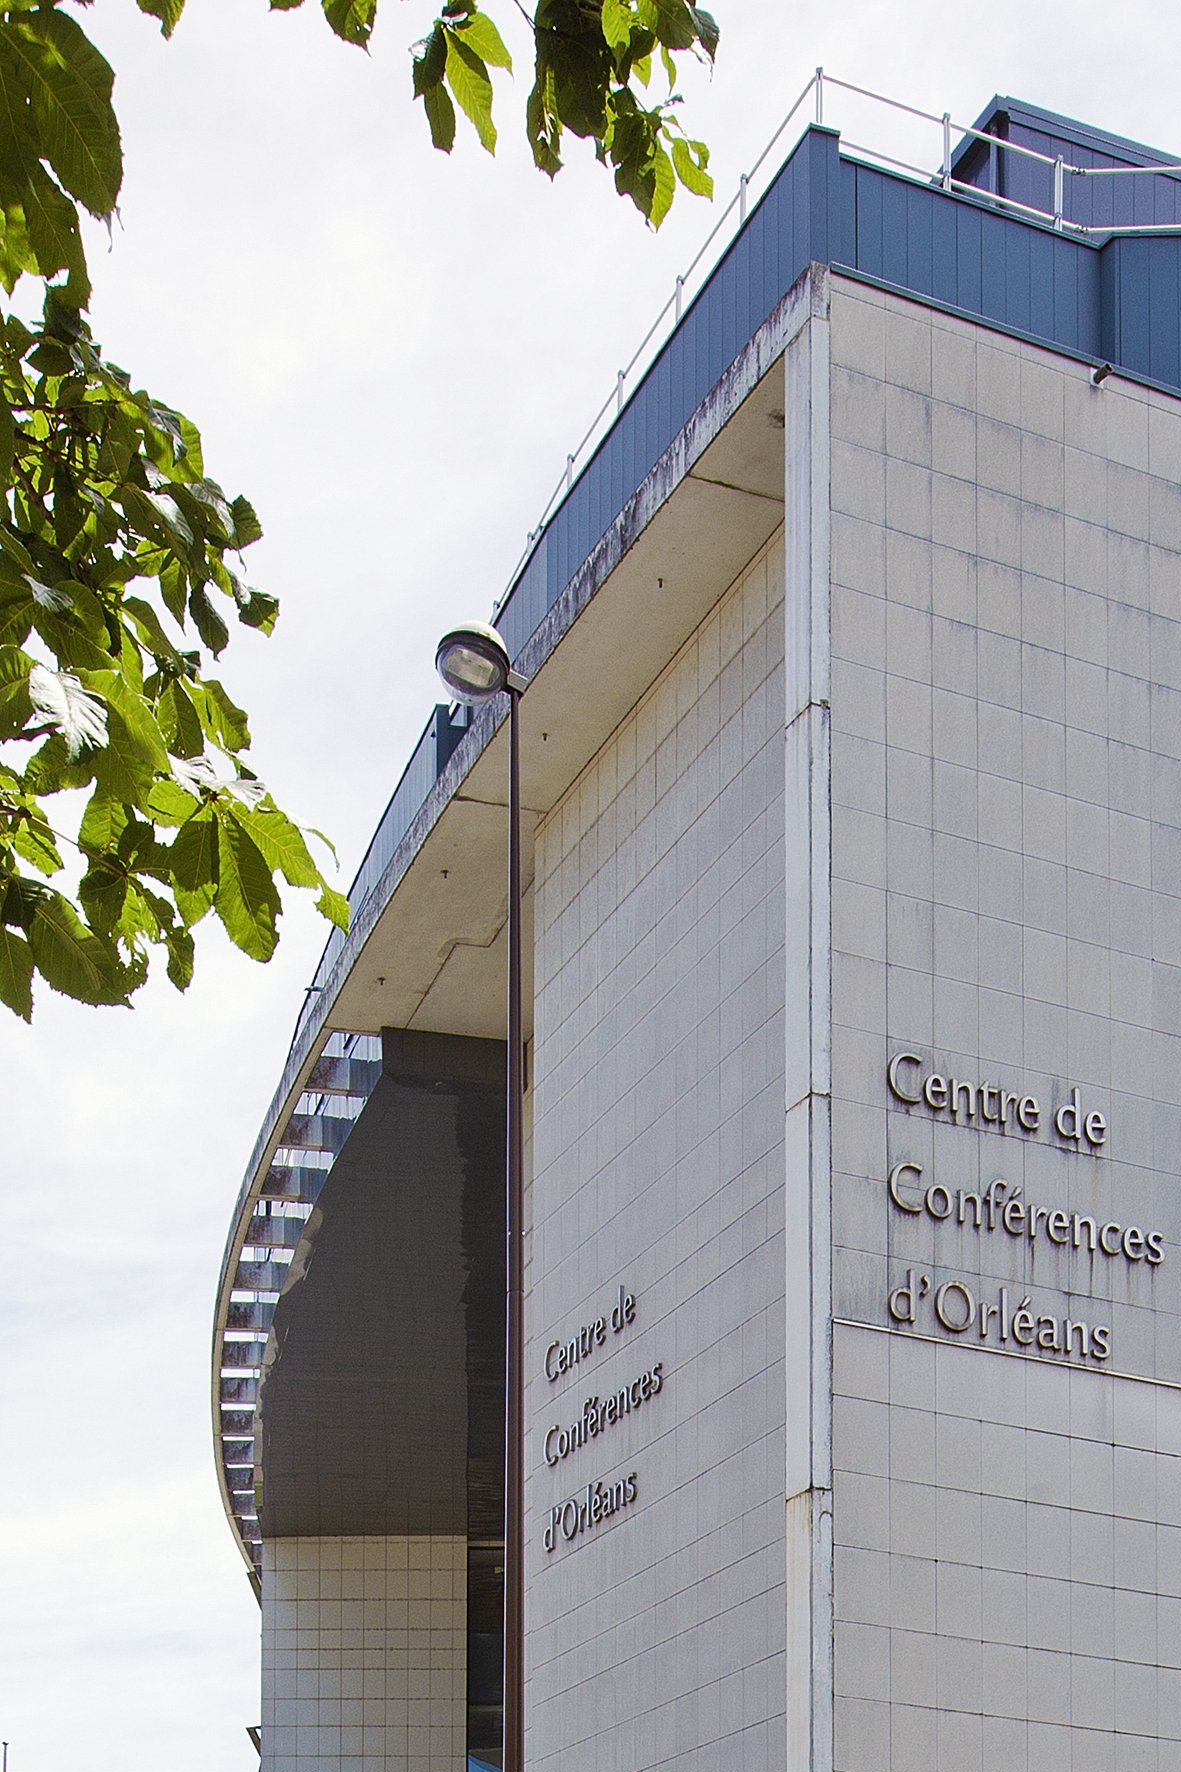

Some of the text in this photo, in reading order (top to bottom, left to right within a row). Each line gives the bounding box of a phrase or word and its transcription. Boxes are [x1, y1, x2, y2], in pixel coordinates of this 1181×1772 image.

[888, 1051, 1108, 1145] Centre de
[889, 1160, 1166, 1263] Conférences
[543, 1285, 637, 1383] Centre de
[889, 1268, 1111, 1360] d'Orléans
[543, 1361, 663, 1467] Conférences
[542, 1471, 638, 1553] d'Orléans
